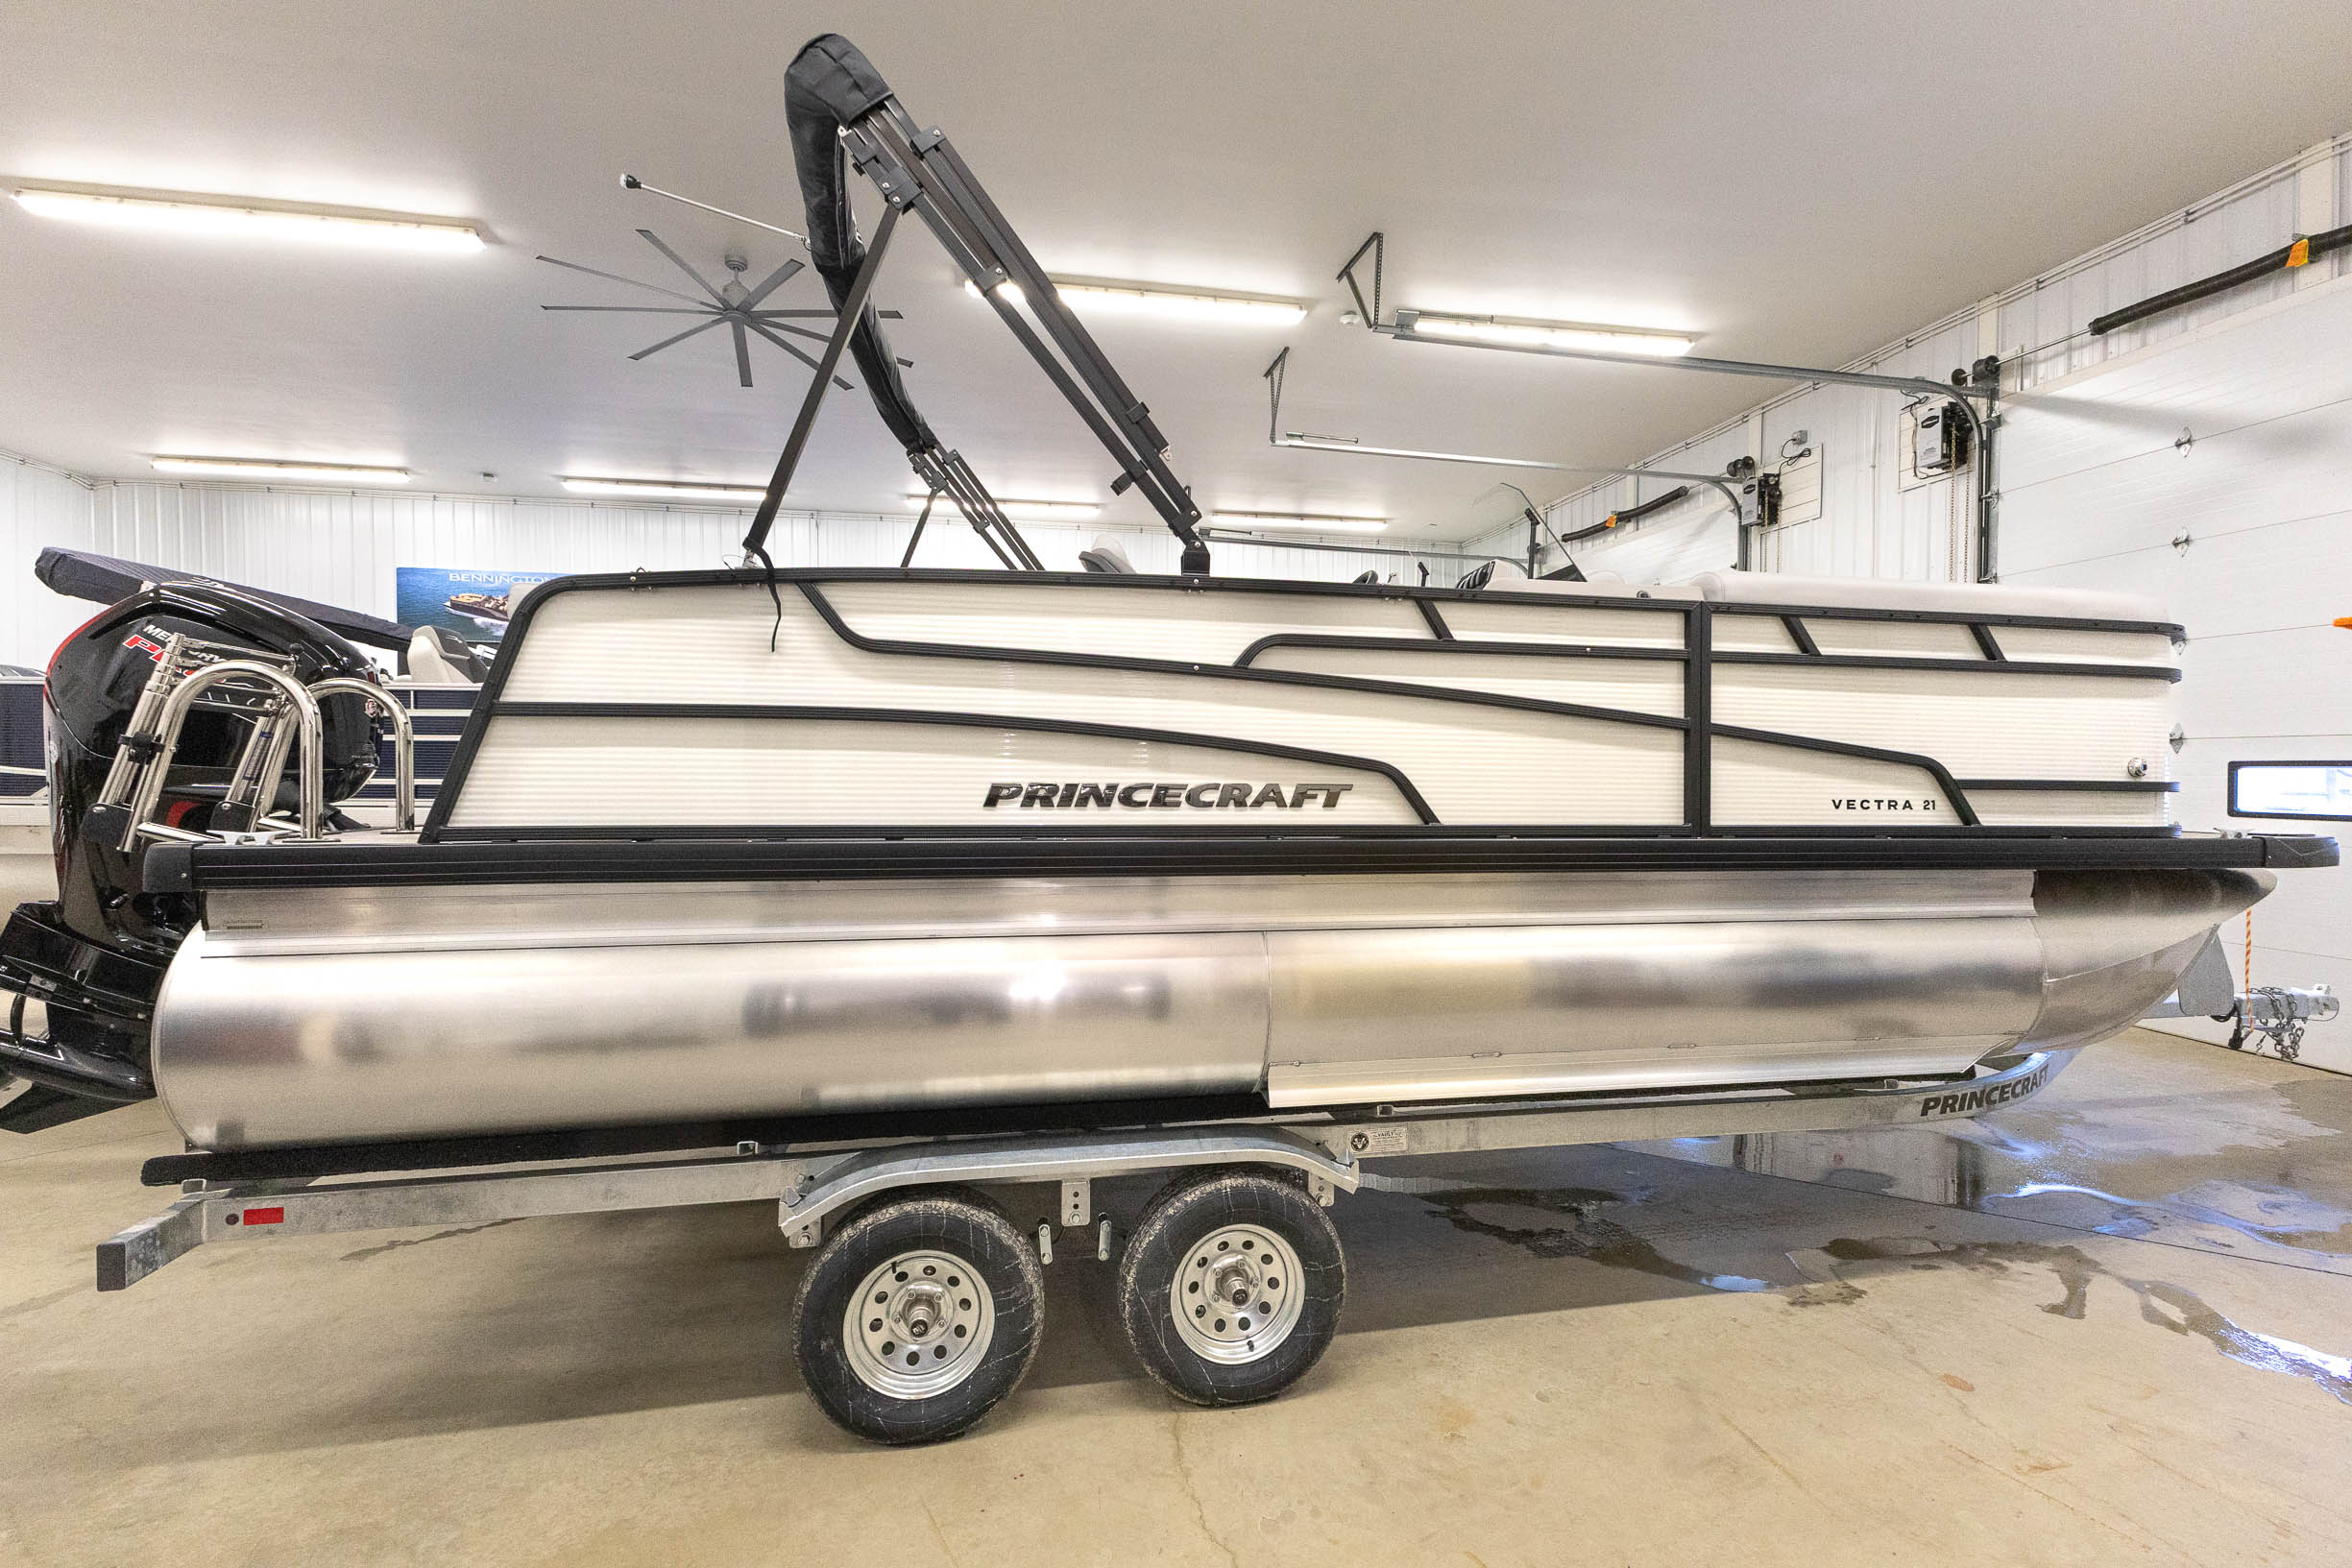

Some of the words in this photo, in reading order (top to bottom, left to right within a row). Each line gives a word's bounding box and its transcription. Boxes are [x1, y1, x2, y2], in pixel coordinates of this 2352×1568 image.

[982, 783, 1354, 808] PRINCECRAFT
[1831, 799, 1914, 810] VECTRA
[1923, 800, 1936, 810] 21
[1920, 1063, 2049, 1118] PRINCECRAFT
